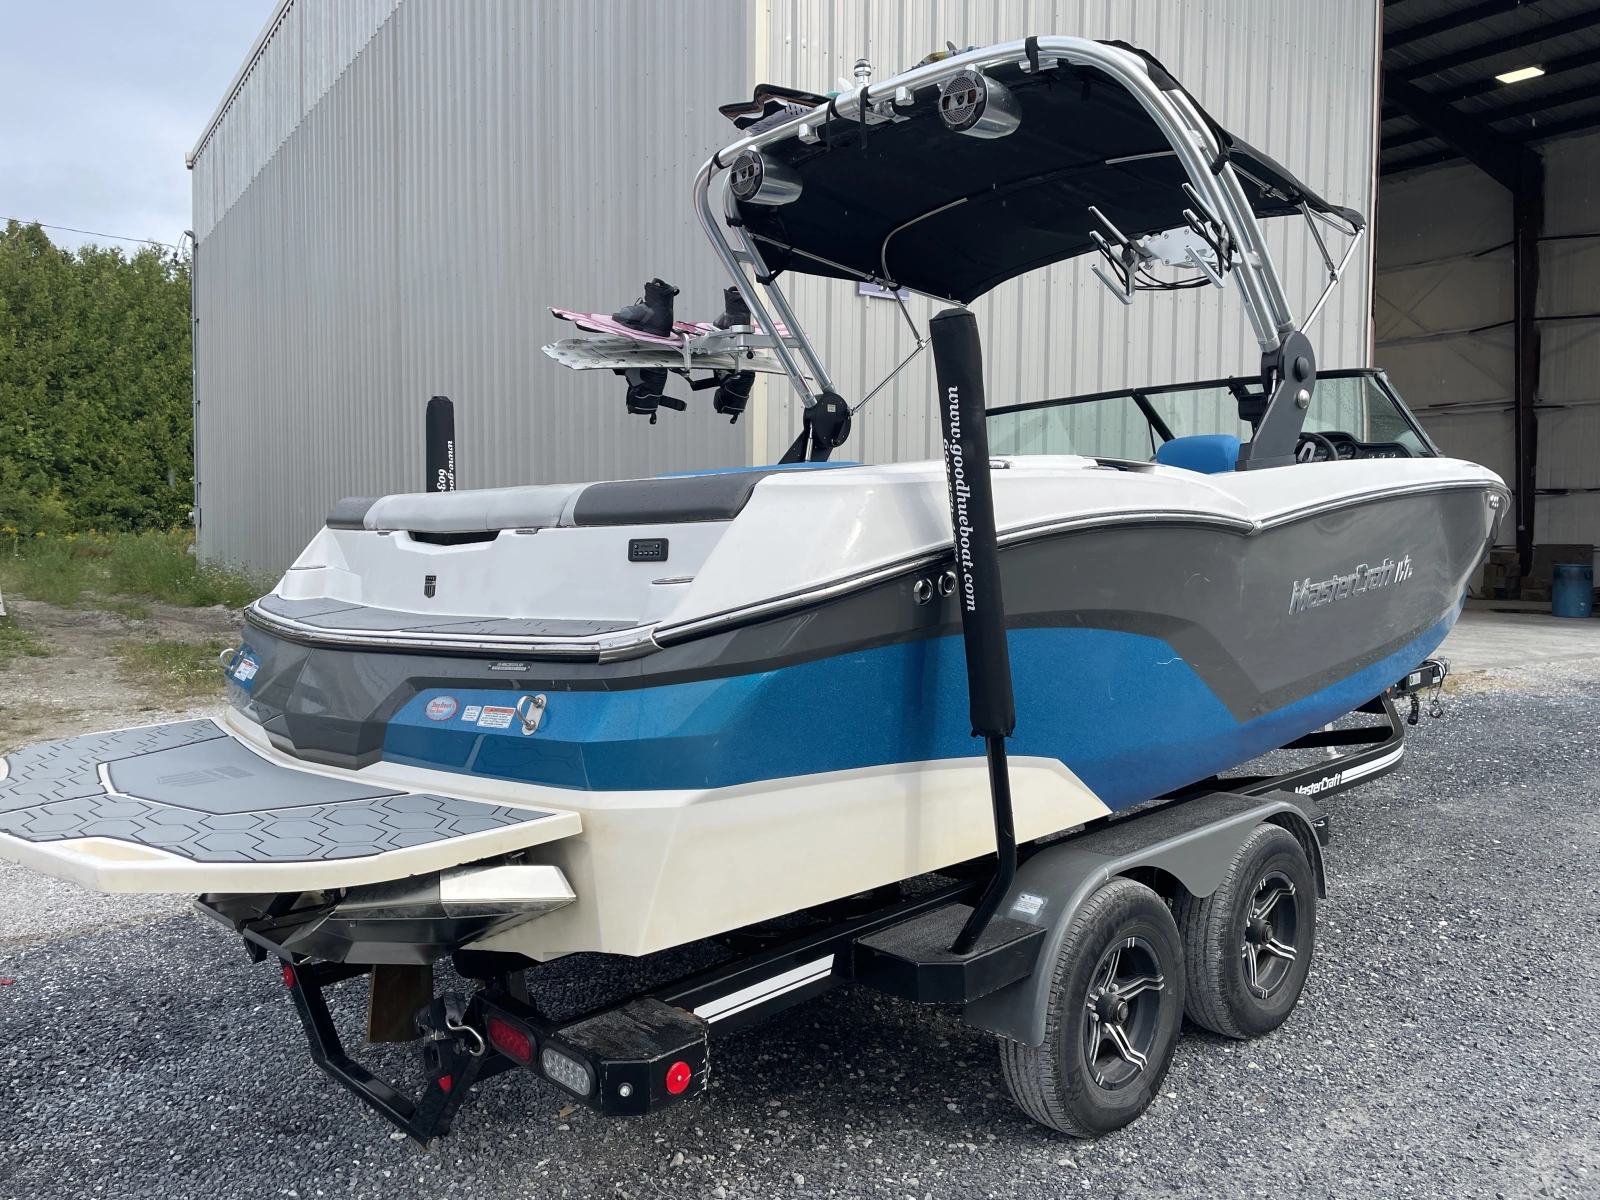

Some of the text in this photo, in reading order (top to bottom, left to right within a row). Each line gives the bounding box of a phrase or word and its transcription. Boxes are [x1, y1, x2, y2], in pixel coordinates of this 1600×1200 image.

[948, 385, 976, 612] www.goodhueboat.com
[1288, 557, 1395, 615] MasterCraft
[1294, 772, 1341, 796] MasterCraft
